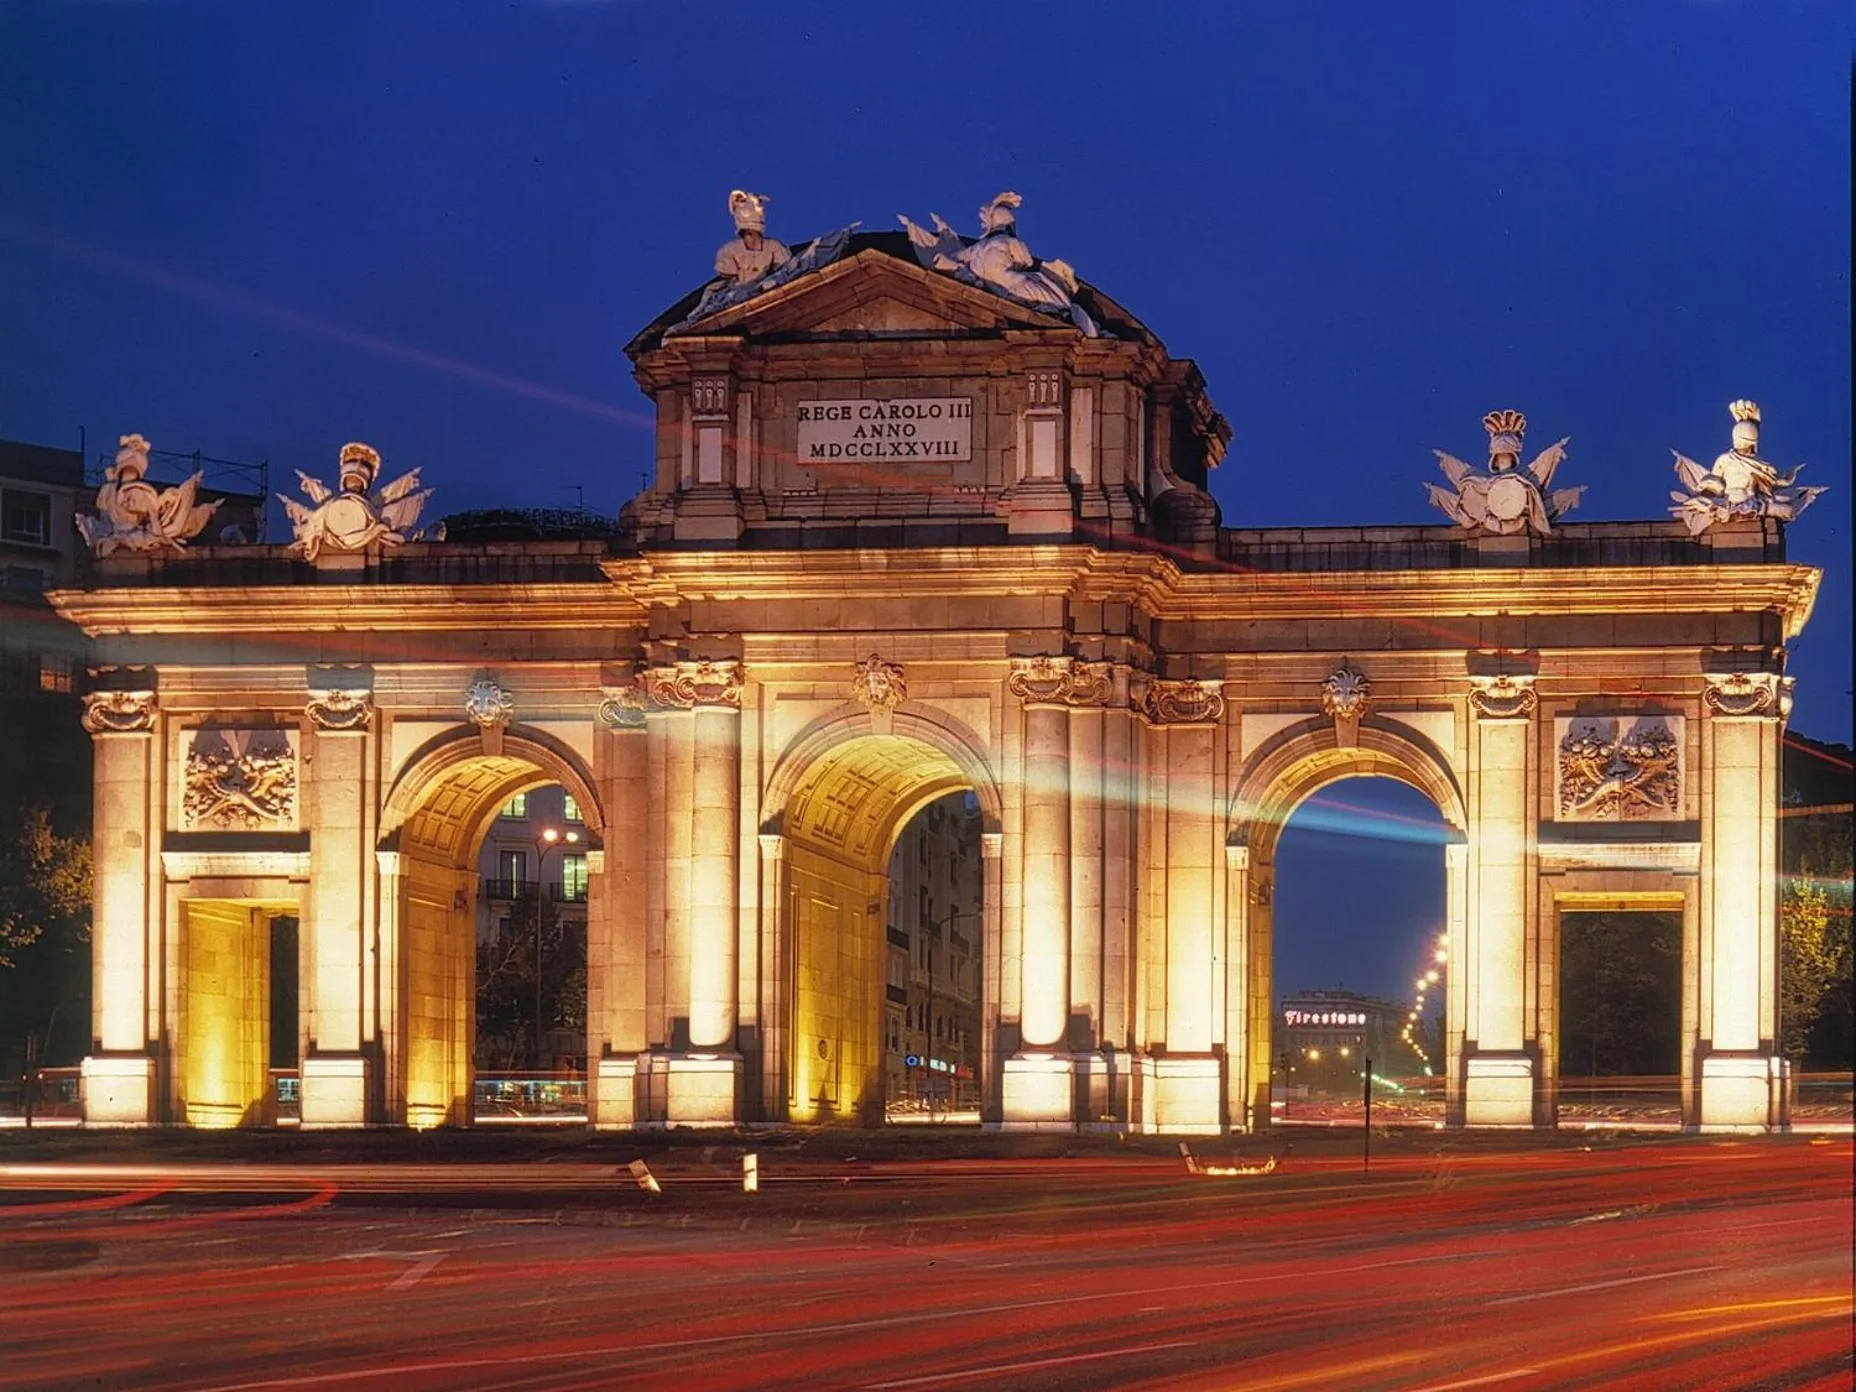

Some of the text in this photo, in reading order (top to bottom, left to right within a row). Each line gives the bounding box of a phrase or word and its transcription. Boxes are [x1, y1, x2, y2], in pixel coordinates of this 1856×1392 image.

[799, 404, 971, 421] REGE CAROLO III
[853, 424, 916, 438] ANNO
[810, 441, 958, 457] MDCCLXXVIII
[1285, 1011, 1366, 1025] Firestone
